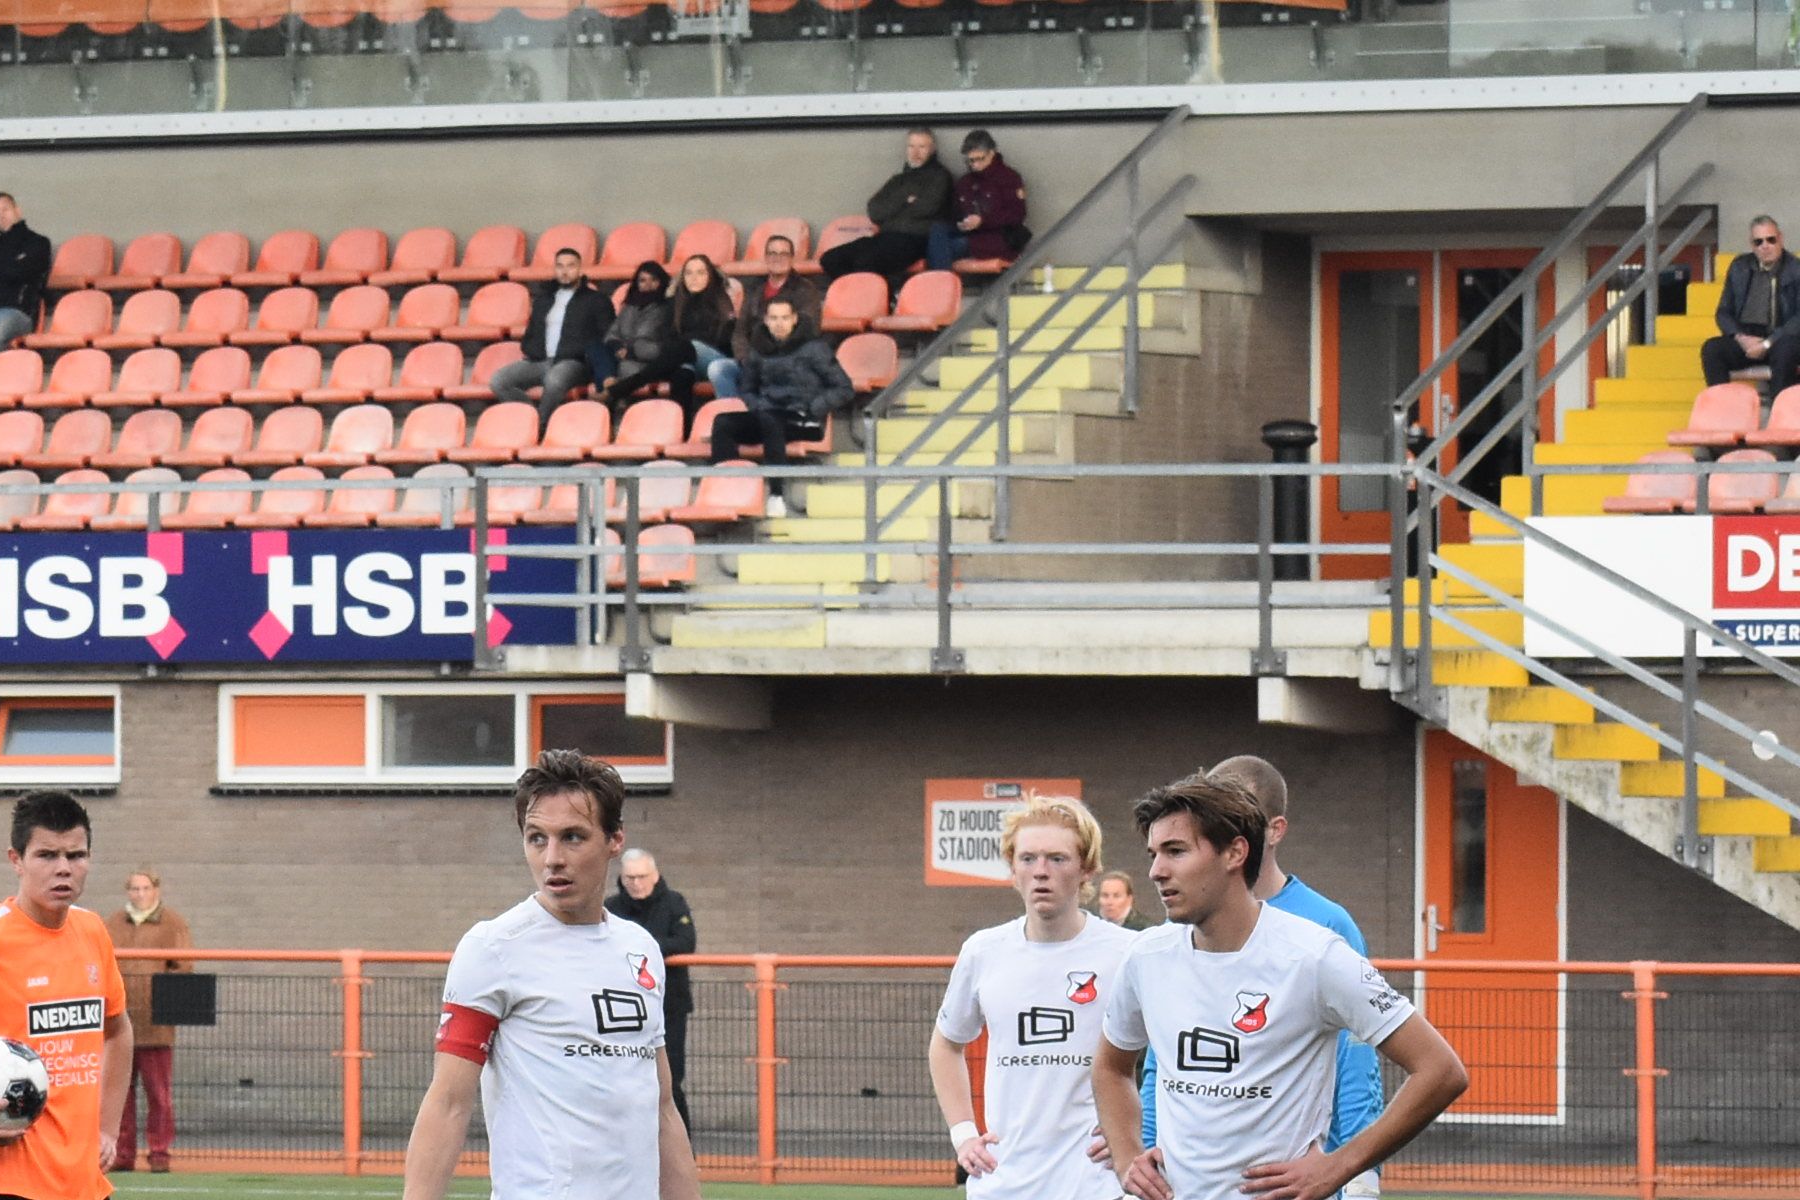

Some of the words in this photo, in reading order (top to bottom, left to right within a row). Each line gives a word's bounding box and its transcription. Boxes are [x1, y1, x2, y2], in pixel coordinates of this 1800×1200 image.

[268, 553, 493, 637] HSB
[939, 809, 955, 832] ZO
[939, 838, 1001, 862] STADION
